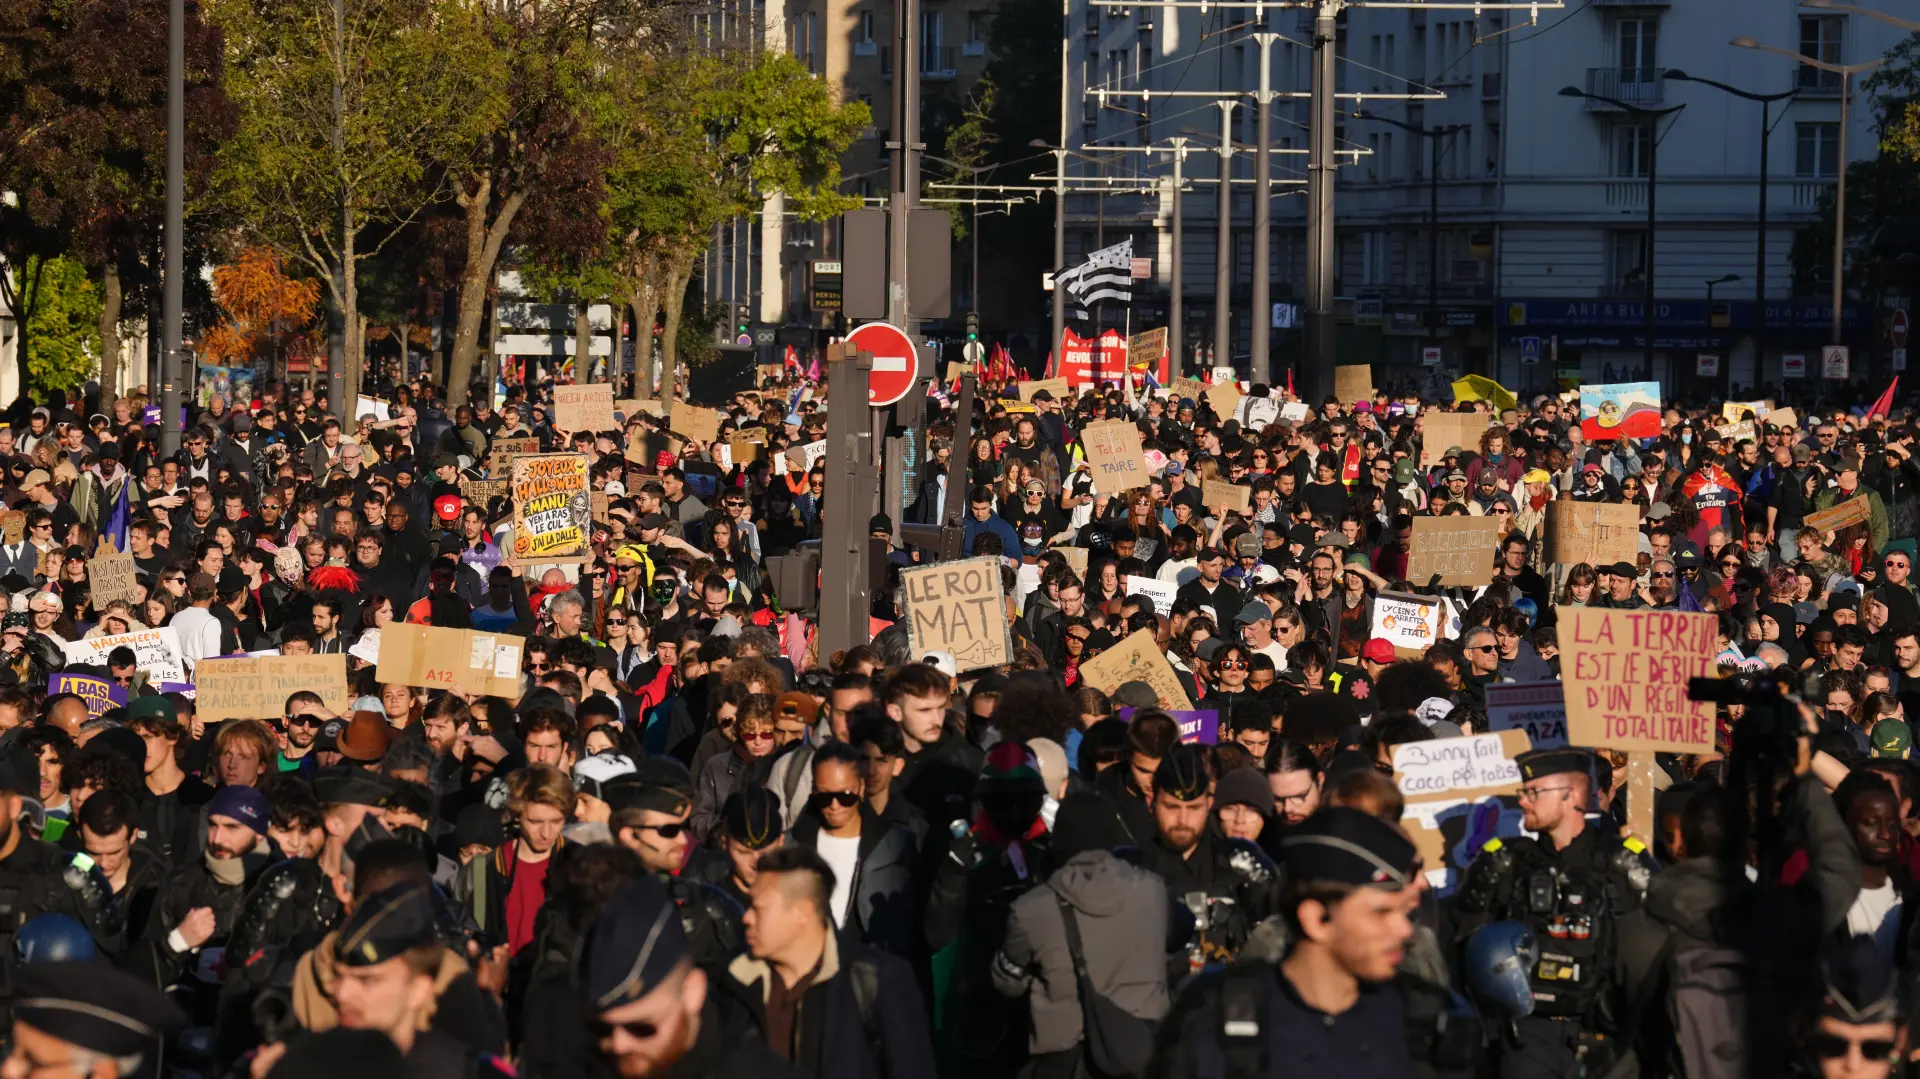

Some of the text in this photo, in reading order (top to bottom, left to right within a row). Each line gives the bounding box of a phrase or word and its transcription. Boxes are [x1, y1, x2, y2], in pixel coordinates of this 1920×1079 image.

[1567, 303, 1670, 317] ART & BLID
[528, 458, 577, 479] JOYEUX
[1101, 459, 1137, 473] TAIRE
[516, 474, 584, 503] HALLOWEEN
[529, 494, 566, 515] MANU
[552, 509, 568, 519] RAS
[1696, 499, 1726, 509] Emirates
[536, 520, 563, 535] LE CUL
[532, 528, 577, 551] J'AI LA DALLE
[909, 574, 941, 603] LE
[1140, 588, 1166, 598] Respect
[914, 596, 996, 648] MAT
[88, 631, 161, 651] HALLOWEEN
[1401, 627, 1425, 638] ETAT
[1574, 612, 1719, 656] LA TERREUR
[162, 670, 179, 679] LES
[425, 669, 454, 682] A12
[1575, 651, 1617, 681] EST
[1622, 652, 1640, 684] LE
[76, 681, 109, 698] BAS
[1586, 684, 1632, 713] D'UN
[1602, 714, 1709, 744] TOTALITAIRE
